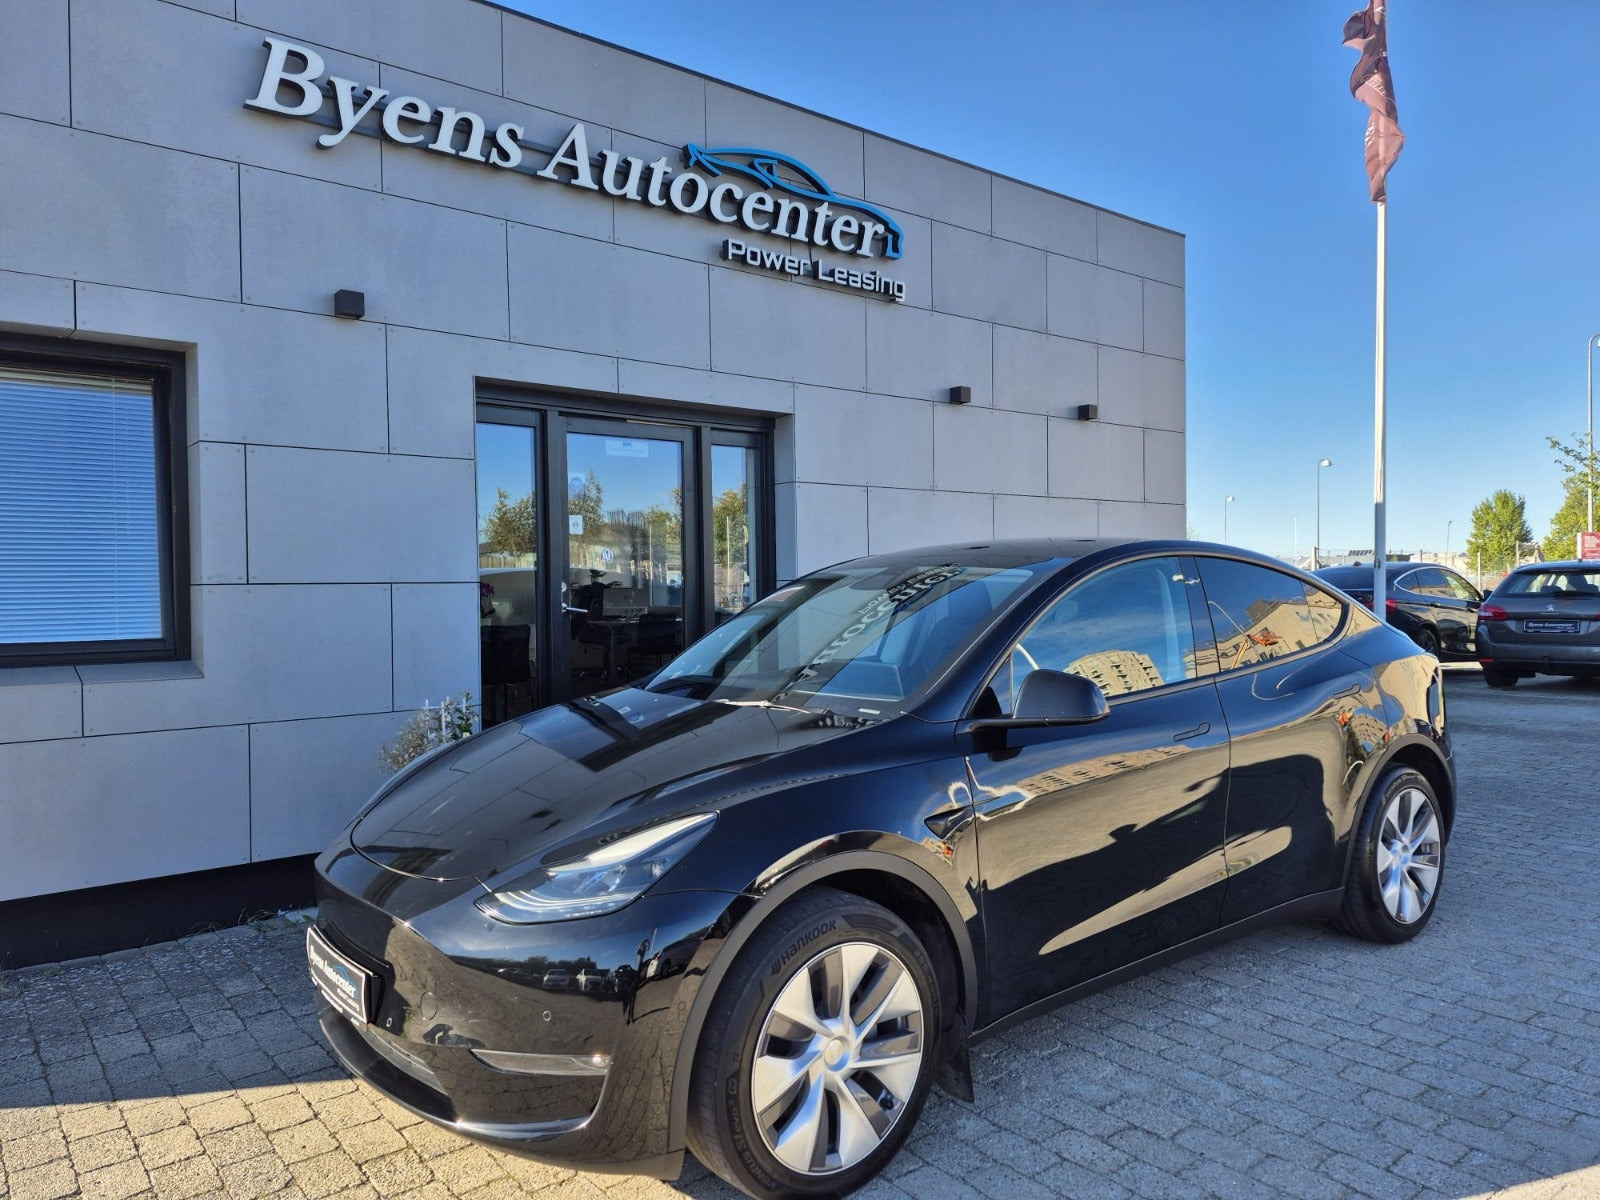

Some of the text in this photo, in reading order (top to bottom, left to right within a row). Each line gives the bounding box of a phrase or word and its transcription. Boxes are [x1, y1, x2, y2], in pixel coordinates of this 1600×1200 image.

[243, 37, 885, 258] Byens Autocenter
[726, 238, 906, 302] Power Leasing
